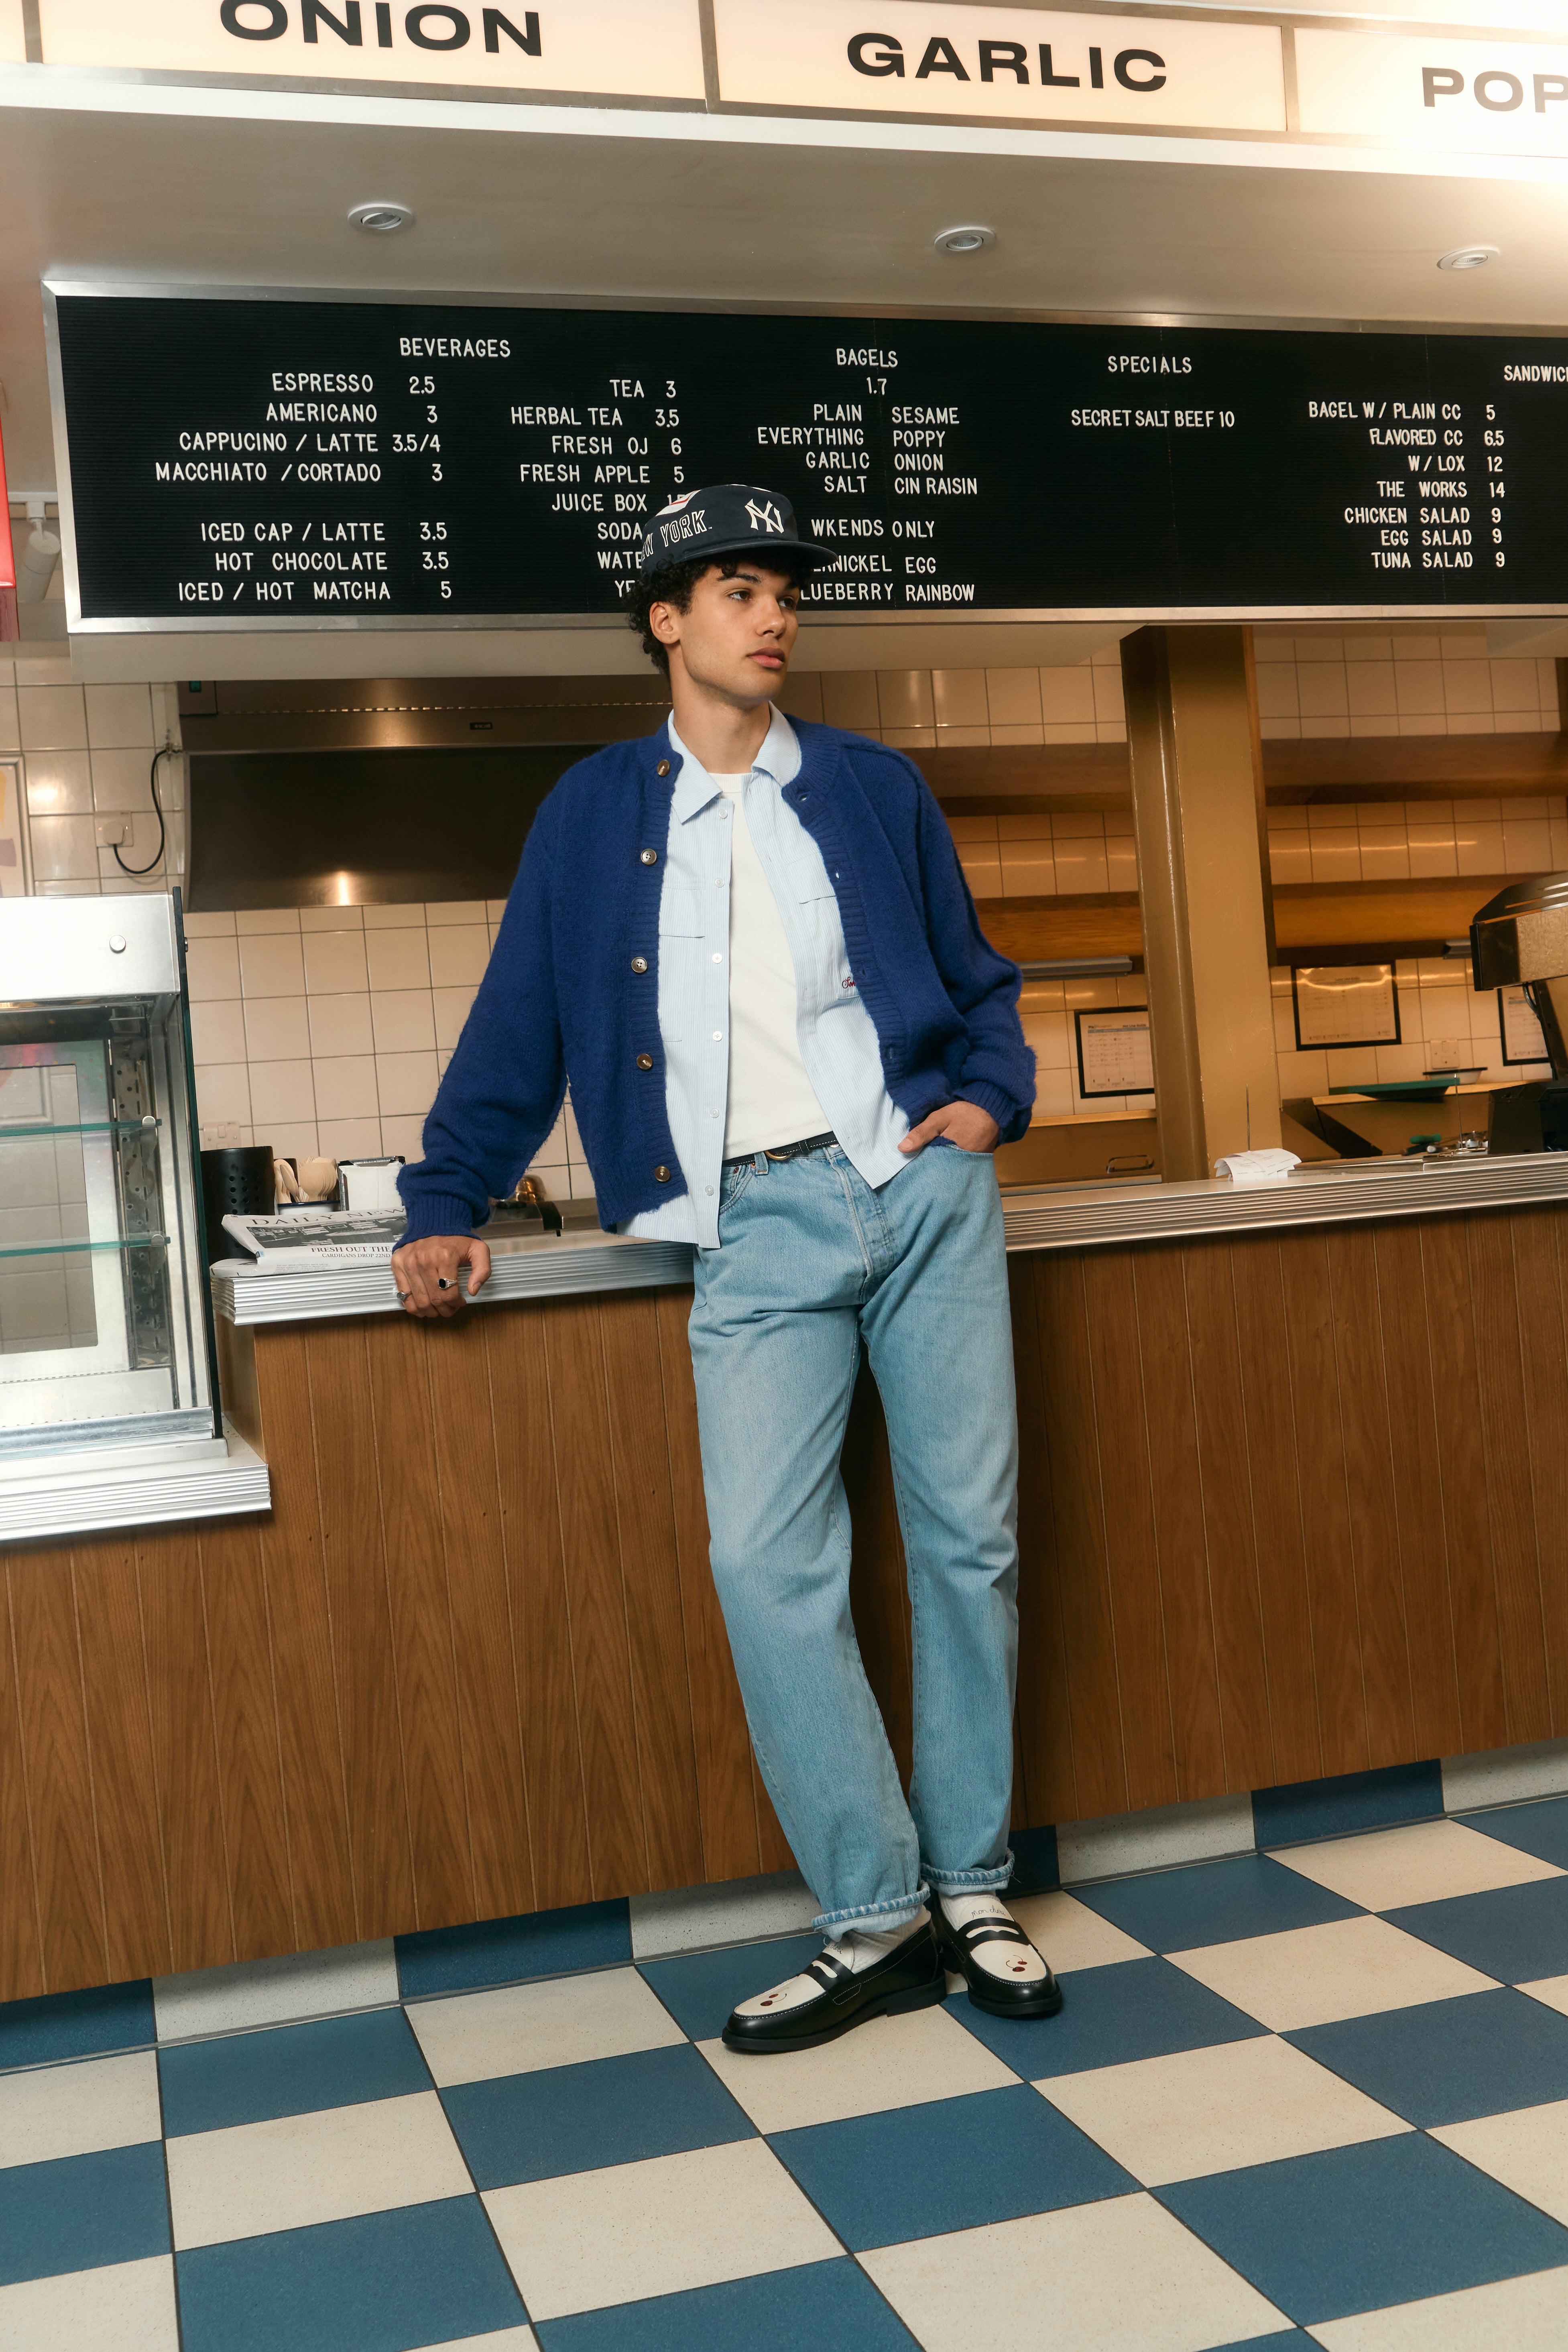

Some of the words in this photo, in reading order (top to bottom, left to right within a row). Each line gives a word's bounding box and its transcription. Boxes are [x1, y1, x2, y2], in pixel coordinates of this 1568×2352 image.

[220, 0, 542, 57] ONION
[847, 32, 1167, 92] GARLIC
[1421, 66, 1568, 114] POP
[399, 337, 511, 358] BEVERAGES
[836, 348, 898, 368] BAGELS
[1107, 355, 1192, 374] SPECIALS
[272, 372, 374, 393] ESPRESSO
[409, 376, 435, 394] 2.5
[1503, 364, 1568, 382] SANDWIC
[609, 379, 645, 398] TEA
[665, 380, 677, 398] 3
[866, 376, 887, 396] 1.7
[266, 402, 377, 423] AMERICANO
[426, 405, 438, 424] 3
[510, 406, 582, 426] HERBAL
[587, 407, 623, 426] TEA
[655, 409, 679, 428] 3.5
[813, 403, 862, 422] PLAIN
[891, 406, 960, 425] SESAME
[1071, 409, 1132, 427] SECRET
[1135, 410, 1171, 428] SALT
[1174, 410, 1215, 428] BEEF
[1219, 411, 1235, 428] 10
[1308, 401, 1359, 419] BAGEL
[1393, 402, 1436, 420] PLAIN
[1441, 403, 1462, 421] CC
[1486, 404, 1496, 421] 5
[179, 431, 287, 452] CAPPUCINO
[295, 433, 307, 452] /
[316, 433, 378, 453] LATTE
[551, 435, 612, 455] FRESH
[627, 437, 648, 455] OJ
[671, 437, 682, 455] 6
[757, 426, 864, 446] EVERYTHING
[893, 429, 946, 448] POPPY
[1369, 427, 1437, 446] FLAVORED
[1444, 429, 1463, 446] CC
[155, 461, 267, 482] MACCHIATO
[431, 463, 443, 482] 3
[805, 451, 870, 470] GARLIC
[894, 453, 944, 472] ONION
[1437, 455, 1466, 472] LOX
[1487, 455, 1503, 472] 12
[520, 463, 580, 483] FRESH
[594, 465, 651, 484] APPLE
[673, 466, 685, 484] 5
[824, 475, 867, 494] SALT
[894, 477, 920, 495] CIN
[926, 477, 978, 495] RAISIN
[1376, 480, 1405, 498] THE
[1418, 481, 1468, 498] WORKS
[1489, 482, 1506, 498] 14
[551, 493, 604, 512] JUICE
[614, 493, 648, 512] BOX
[1344, 506, 1407, 524] CHICKEN
[1420, 507, 1470, 524] SALAD
[1491, 507, 1501, 524] 9
[201, 522, 245, 542] ICED
[254, 522, 293, 542] CAP
[301, 522, 312, 542] /
[322, 522, 386, 542] LATTE
[419, 522, 447, 541] 3.5
[660, 509, 708, 547] YORK
[811, 518, 884, 537] WKENDS
[892, 520, 935, 538] ONLY
[1380, 529, 1409, 547] EGG
[1422, 529, 1472, 546] SALAD
[1492, 527, 1502, 544] 9
[215, 552, 254, 571] HOT
[272, 551, 388, 571] CHOCOLATE
[422, 551, 449, 570] 3.5
[597, 551, 642, 569] WATE
[905, 556, 936, 574] EGG
[1371, 551, 1412, 569] TUNA
[1422, 551, 1473, 569] SALAD
[1495, 551, 1505, 568] 9
[178, 582, 224, 602] ICED
[232, 582, 244, 601] /
[256, 581, 295, 601] HOT
[313, 581, 391, 601] MATCHA
[440, 580, 452, 599] 5
[905, 583, 975, 602] RAINBOW
[250, 1214, 334, 1225] DAILY
